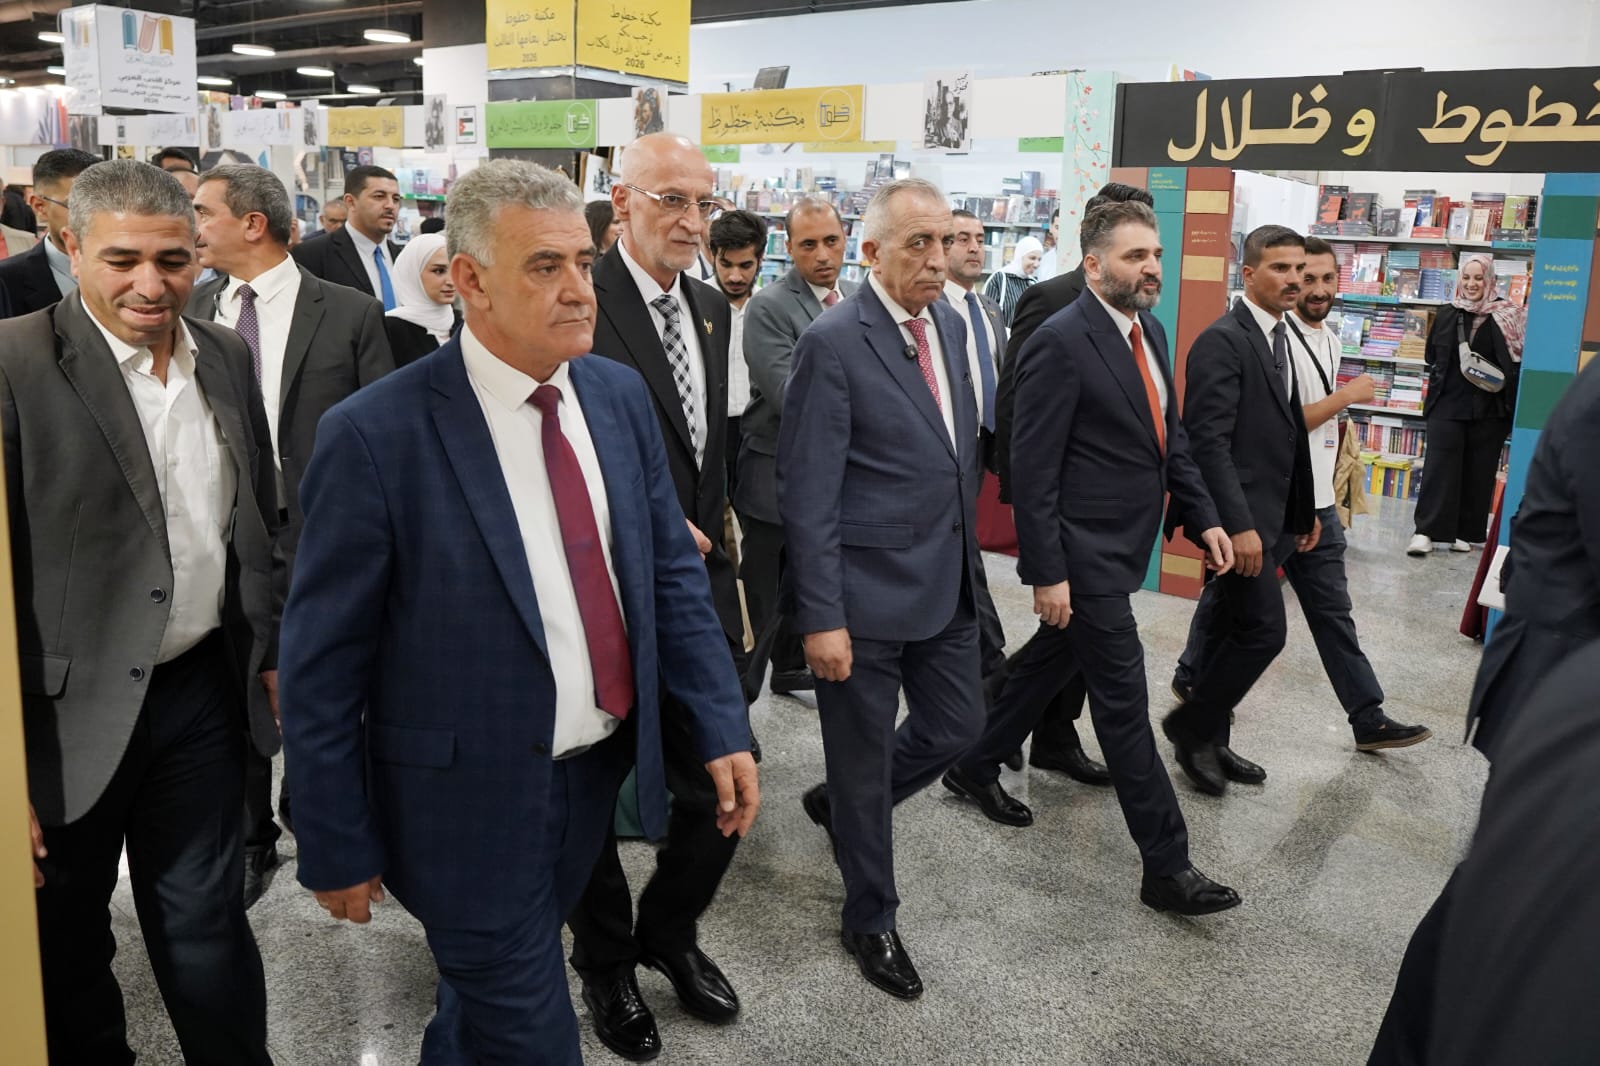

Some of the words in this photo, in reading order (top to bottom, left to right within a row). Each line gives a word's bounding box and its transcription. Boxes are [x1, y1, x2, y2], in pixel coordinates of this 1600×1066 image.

[610, 4, 638, 22] خطوط
[640, 11, 662, 26] مكتبة
[625, 57, 646, 69] 2026
